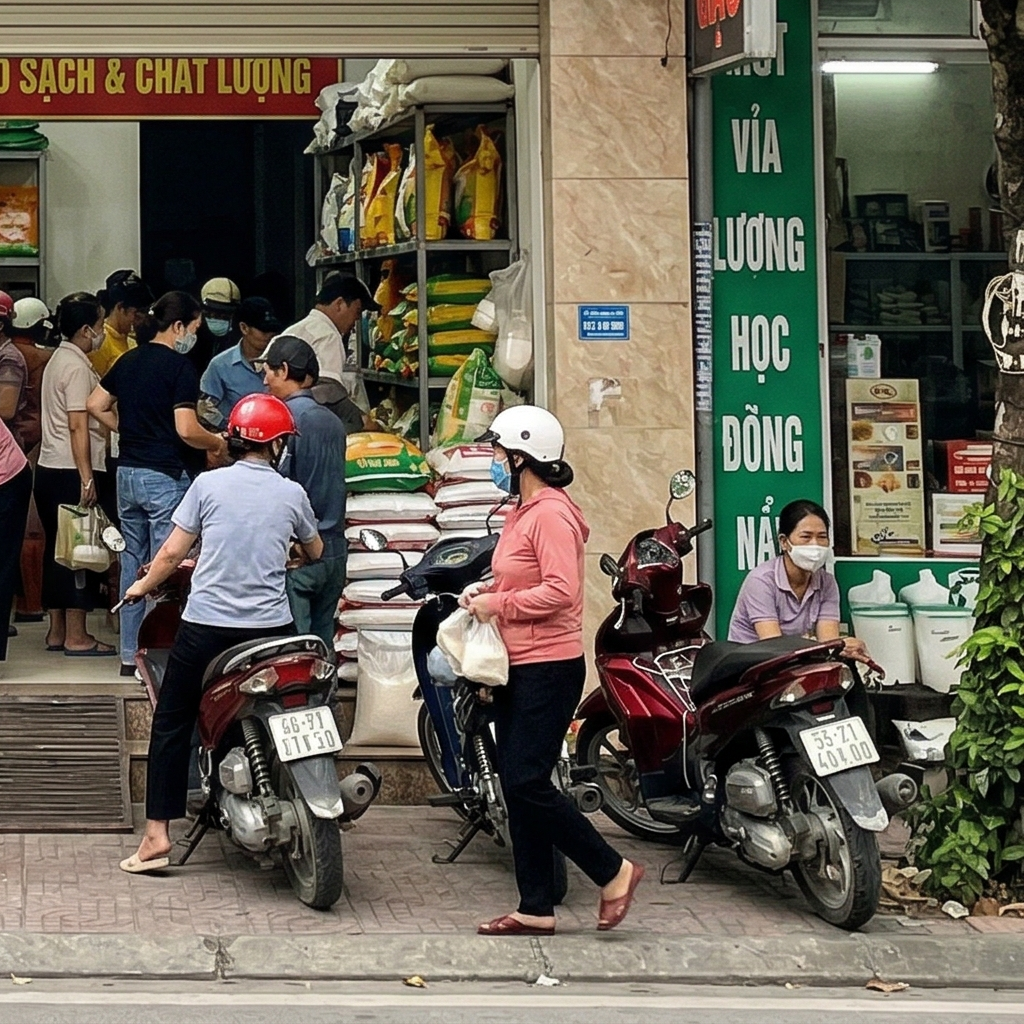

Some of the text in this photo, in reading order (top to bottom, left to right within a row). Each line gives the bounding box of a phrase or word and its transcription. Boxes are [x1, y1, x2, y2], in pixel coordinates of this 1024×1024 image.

[20, 58, 95, 103] SẠCH
[104, 58, 126, 94] &
[731, 315, 790, 384] HỌC
